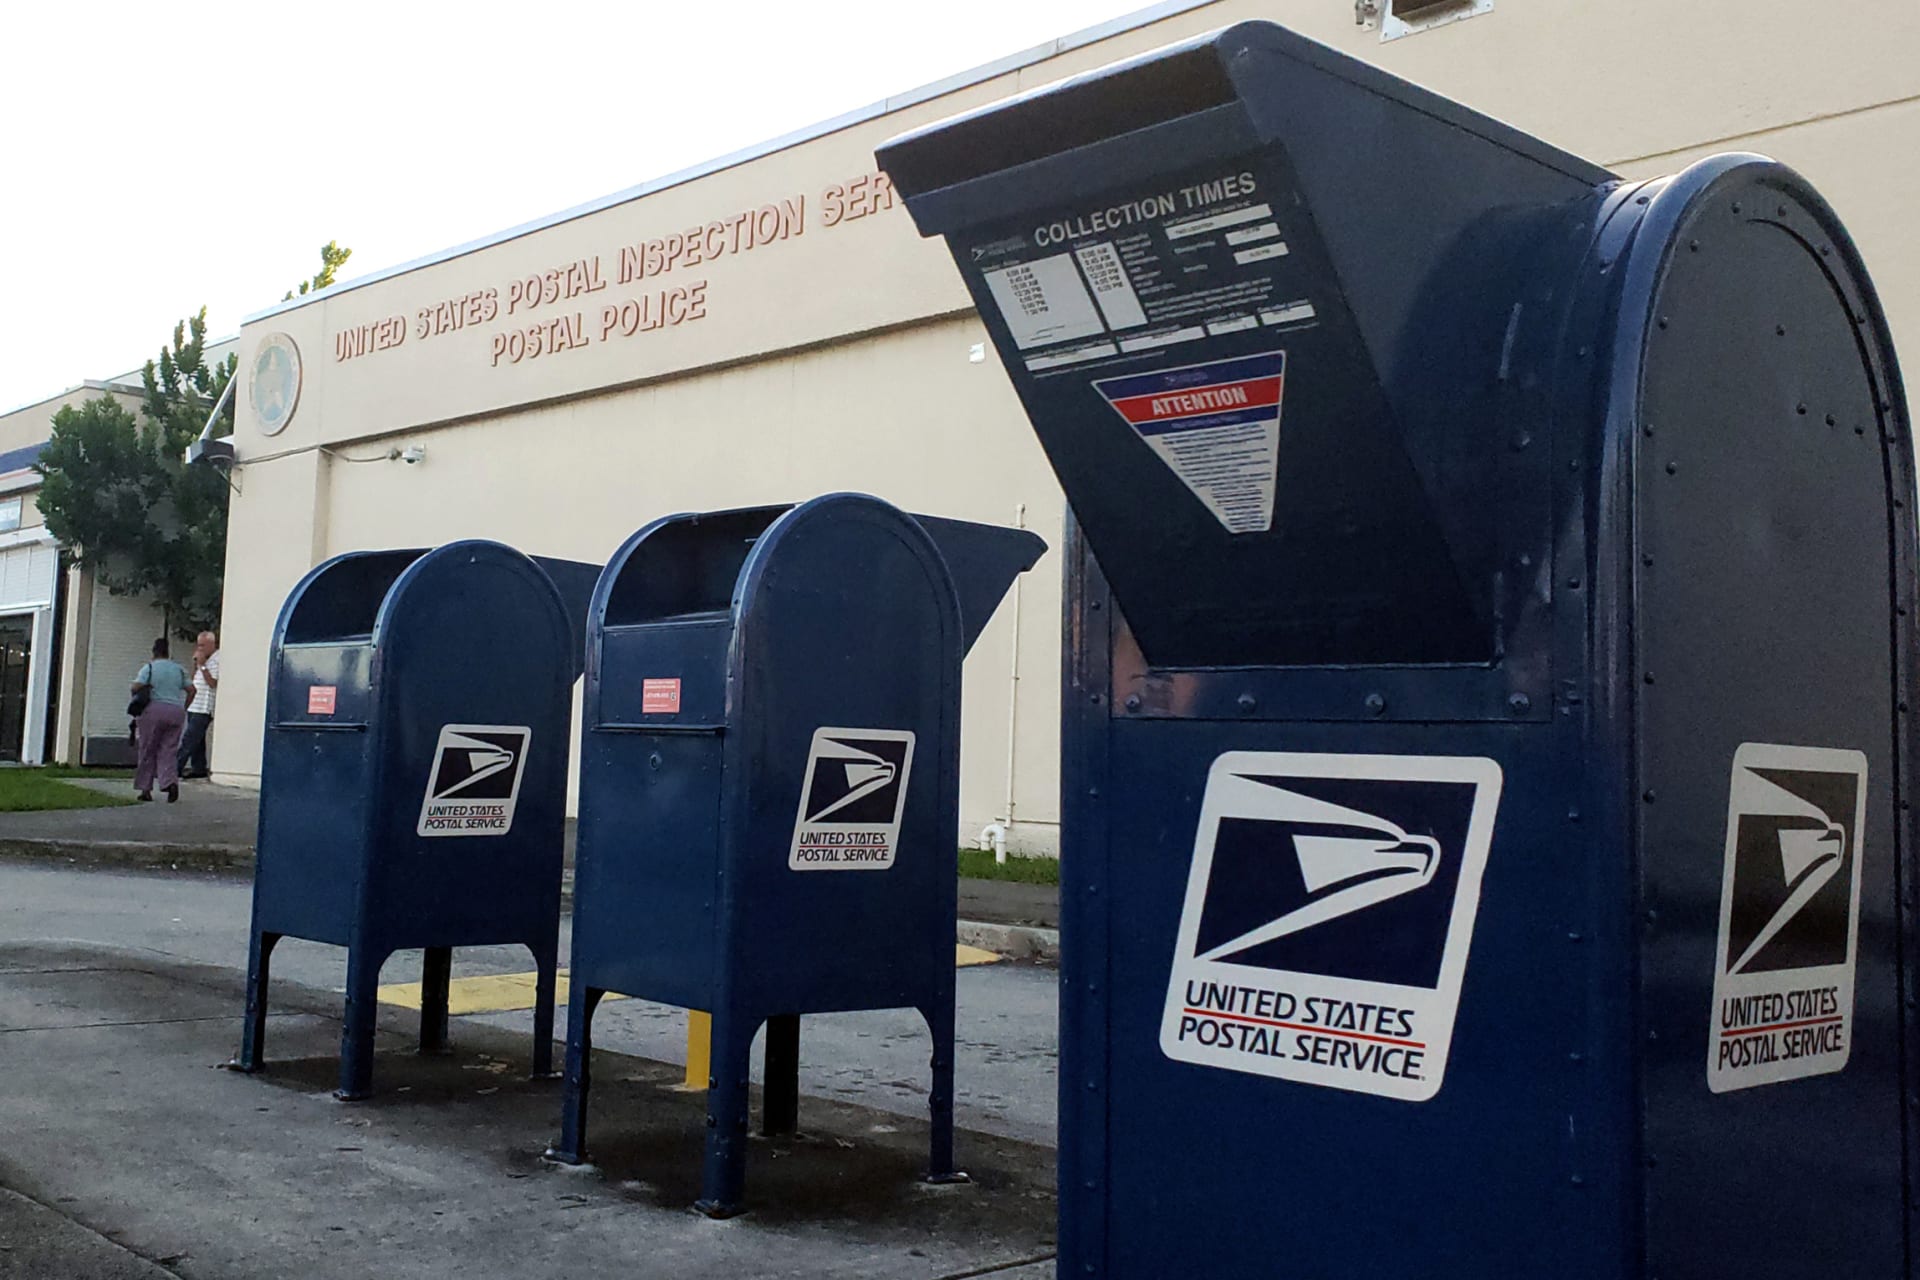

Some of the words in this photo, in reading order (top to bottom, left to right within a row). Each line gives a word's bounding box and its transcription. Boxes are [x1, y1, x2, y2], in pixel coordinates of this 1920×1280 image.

[1034, 193, 1176, 247] COLLECTION
[1180, 172, 1257, 209] TIMES
[335, 315, 407, 362] UNITED
[416, 287, 498, 340] STATES
[507, 255, 607, 315] POSTAL
[617, 194, 805, 284] INSPECTION
[490, 312, 589, 367] POSTAL
[600, 279, 708, 342] POLICE
[1151, 387, 1248, 416] ATTENTION
[424, 819, 463, 830] POSTAL
[465, 818, 507, 829] SERVICE
[427, 805, 468, 816] UNITED
[468, 805, 505, 816] STATES
[796, 848, 841, 862] POSTAL
[842, 848, 889, 862] SERVICE
[800, 832, 845, 845] UNITED
[846, 832, 886, 845] STATES
[1185, 979, 1297, 1020] UNITED
[1302, 996, 1415, 1038] STATES
[1721, 991, 1783, 1029] UNITED
[1785, 986, 1839, 1020] STATES
[1178, 1016, 1286, 1058] POSTAL
[1292, 1034, 1425, 1080] SERVICE
[1718, 1033, 1780, 1070] POSTAL
[1782, 1023, 1844, 1061] SERVICE
